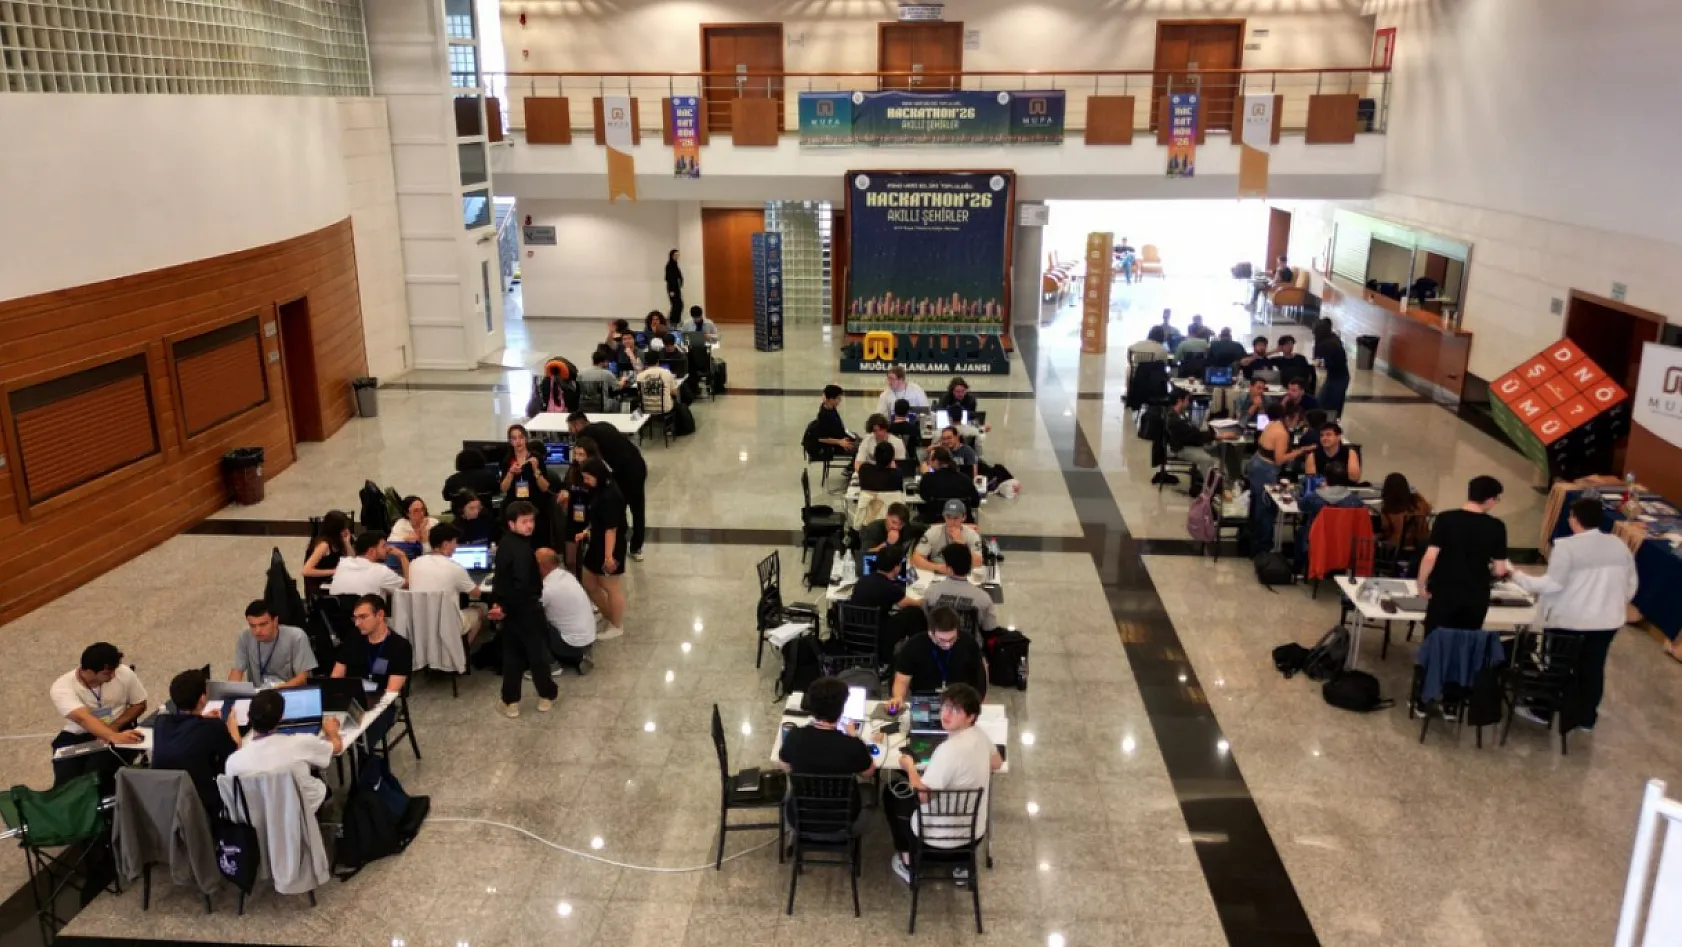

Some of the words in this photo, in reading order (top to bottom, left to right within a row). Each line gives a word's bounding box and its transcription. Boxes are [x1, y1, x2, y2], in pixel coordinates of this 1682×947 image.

[888, 107, 976, 120] HACKATHON'26
[1022, 116, 1053, 124] MUPA
[866, 191, 993, 208] HACKATHON'26
[887, 209, 920, 222] AKILLI
[922, 207, 969, 226] ŞEHİRLER
[898, 333, 1007, 361] MUPA
[955, 363, 991, 372] AJANSI
[1648, 397, 1682, 412] MU
